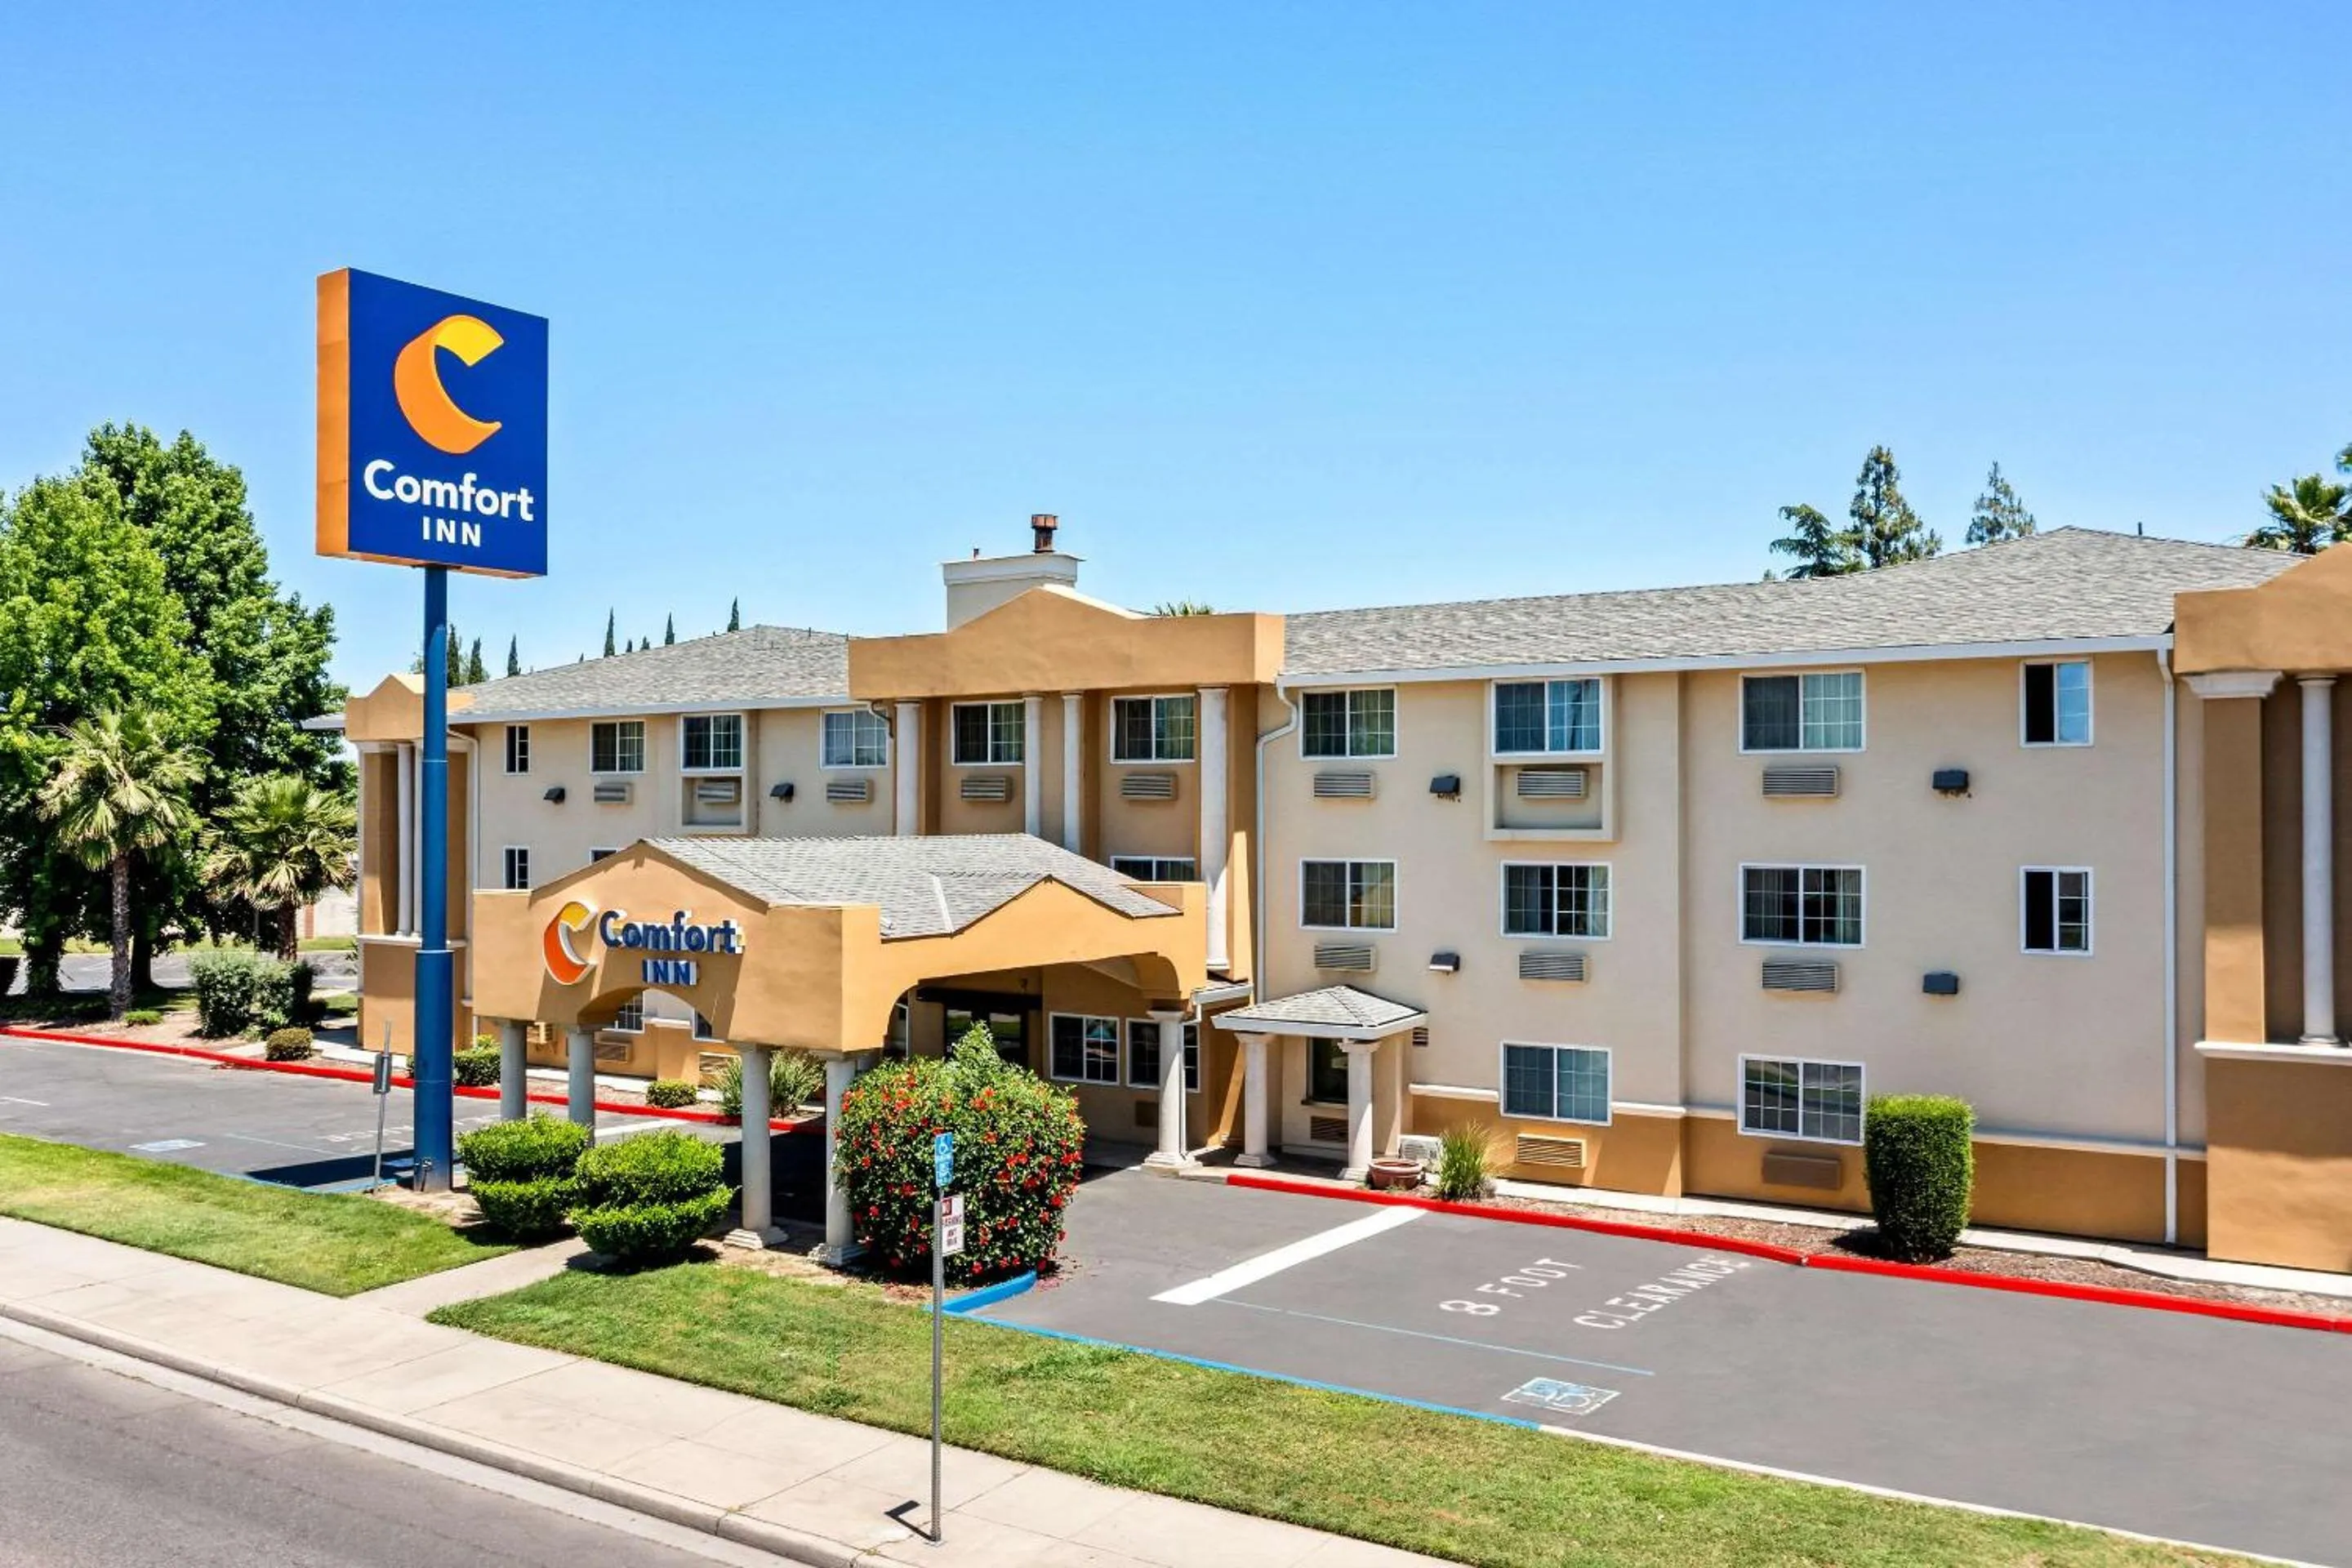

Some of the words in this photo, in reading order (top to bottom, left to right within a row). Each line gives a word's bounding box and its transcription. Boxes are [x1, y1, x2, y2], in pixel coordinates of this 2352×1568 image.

[363, 459, 534, 522] Comfort
[422, 516, 481, 546] INN
[599, 910, 742, 954] Comfort
[642, 959, 697, 986] INN
[1439, 1299, 1501, 1316] 8
[1475, 1258, 1584, 1298] FOOT
[1573, 1254, 1751, 1330] CLEARANCE
